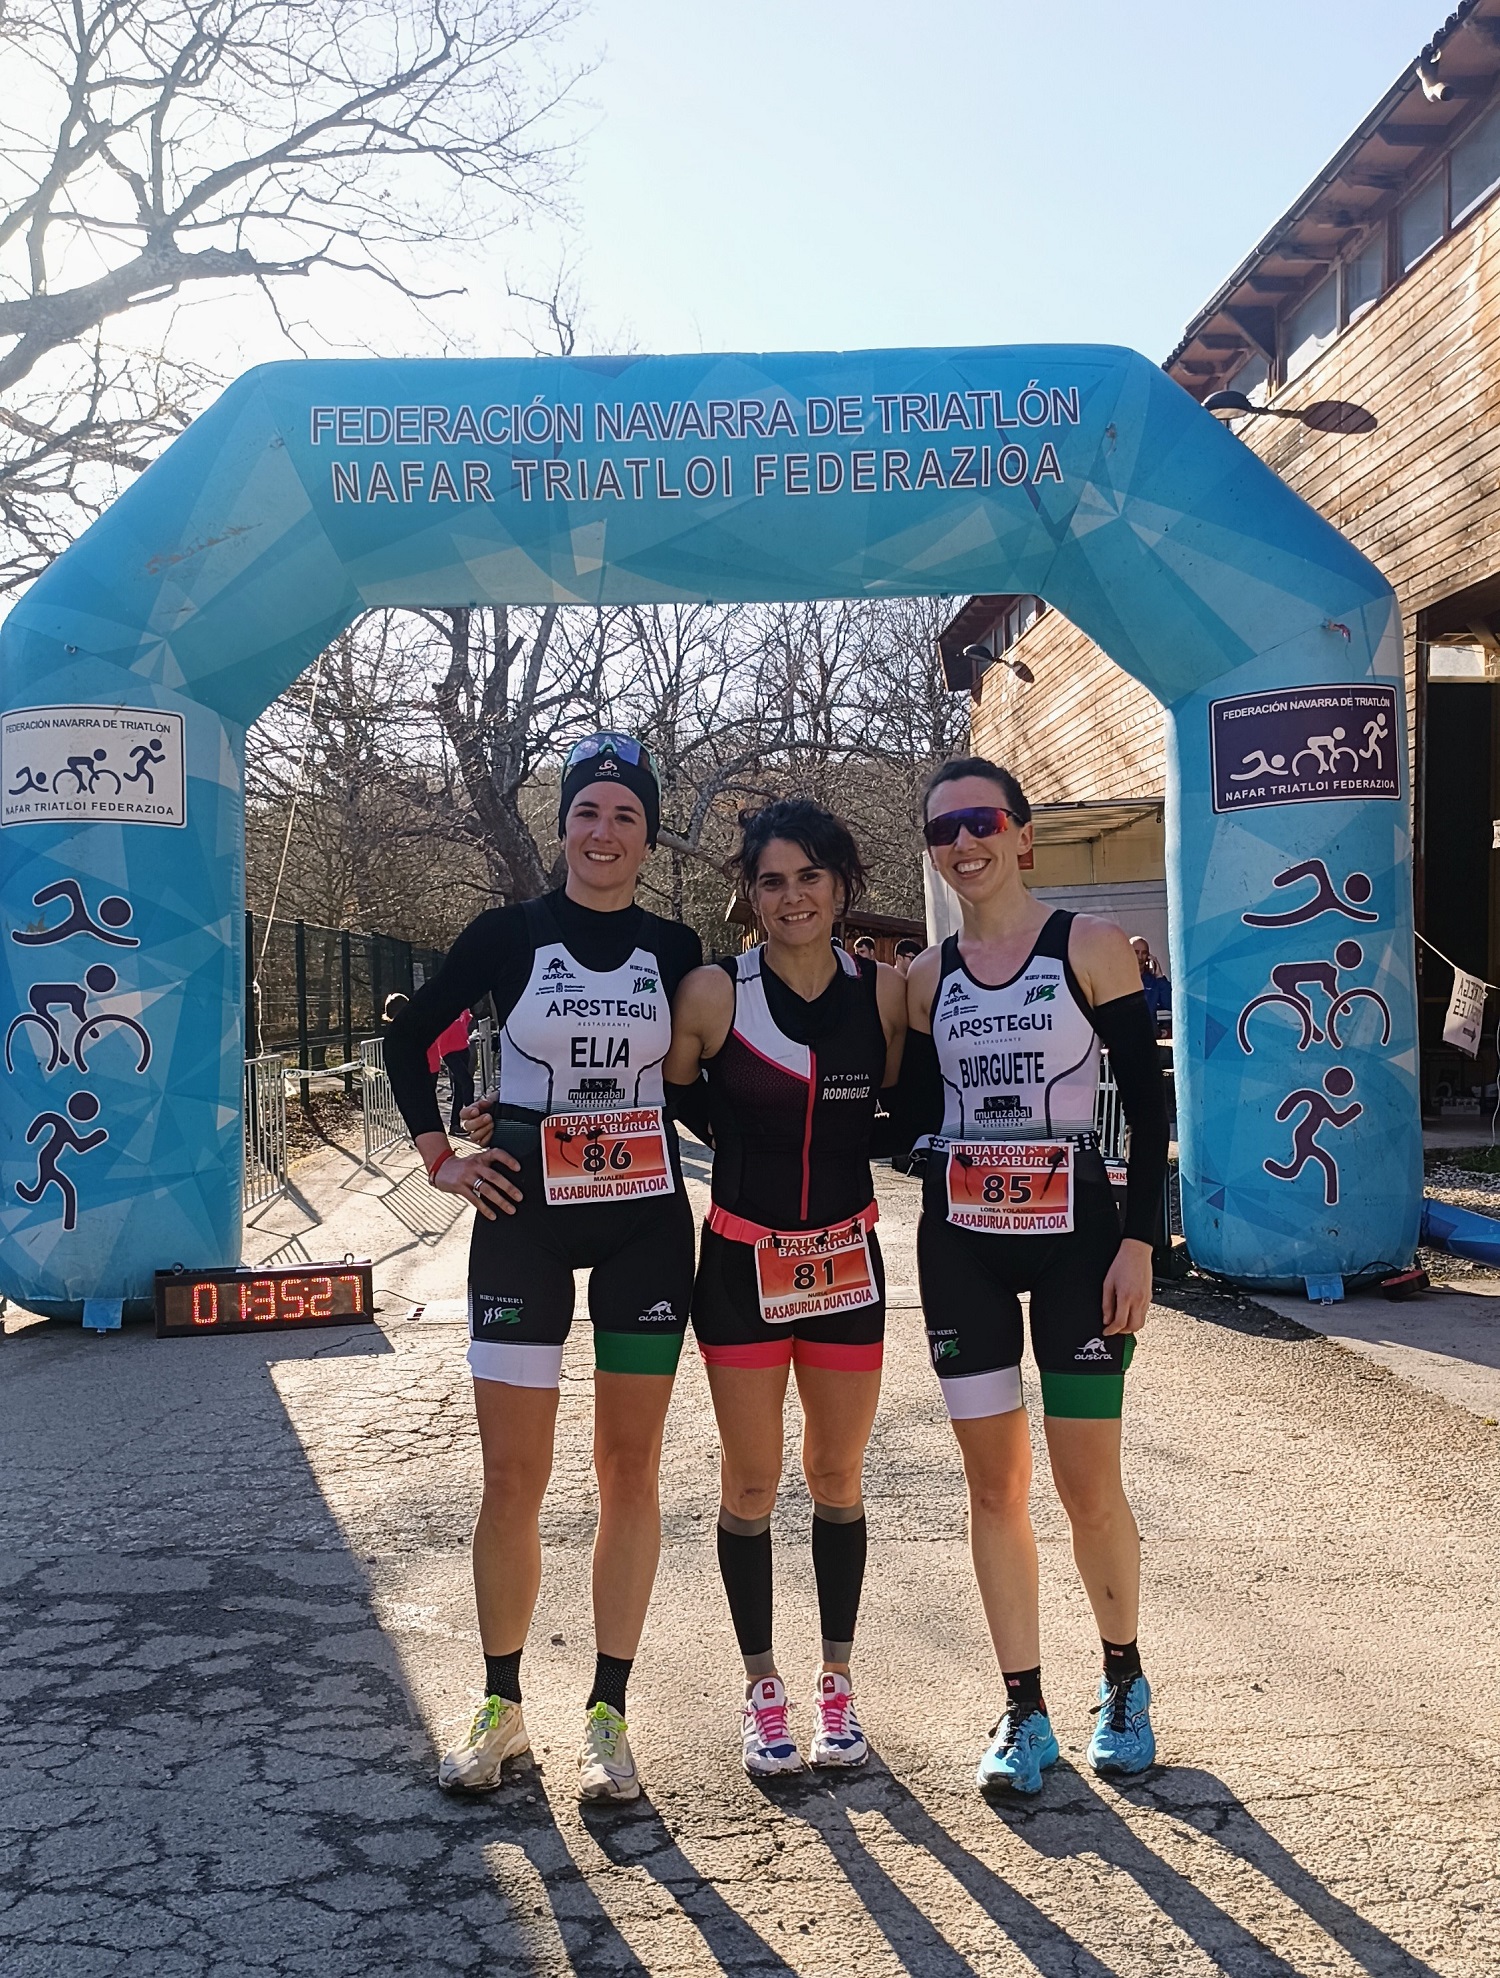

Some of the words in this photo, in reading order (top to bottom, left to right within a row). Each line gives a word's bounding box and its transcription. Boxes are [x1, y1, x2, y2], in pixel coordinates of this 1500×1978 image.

[310, 395, 583, 446] FEDERACIÓN
[595, 398, 798, 442] NAVARRA
[806, 395, 865, 437] DE
[872, 380, 1081, 434] TRIATLÓN
[331, 460, 496, 503] NAFAR
[512, 455, 732, 501] TRIATLOI
[755, 442, 1064, 497] FEDERAZIOA
[1222, 701, 1288, 721] FEDERACIÓN
[1290, 698, 1339, 710] NAVARRA
[1340, 697, 1353, 707] DE
[1355, 696, 1390, 708] TRIATLÓN
[5, 718, 51, 734] FEDERACIÓN
[52, 718, 100, 728] NAVARRA
[102, 719, 118, 729] DE
[120, 720, 171, 734] TRIATLÓN
[1225, 787, 1266, 802] NAFAR
[1270, 781, 1329, 795] TRIATLOI
[1333, 779, 1395, 790] FEDERAZIOA
[5, 804, 31, 815] NAFAR
[34, 802, 87, 812] TRIATLOI
[91, 802, 174, 816] FEDERAZIOA
[974, 1037, 1022, 1046] RESTAURANTE
[570, 1036, 630, 1069] ELIA
[823, 1073, 870, 1082] APTONIA
[958, 1051, 1046, 1089] BURGUETE
[569, 1088, 624, 1100] muruzabal
[822, 1086, 871, 1100] RODRIGUEZ
[545, 1118, 556, 1127] III
[560, 1113, 622, 1127] DUATLON
[975, 1106, 1031, 1120] muruzabal
[567, 1120, 659, 1136] BASABURUA
[582, 1140, 633, 1173] 86
[952, 1145, 963, 1155] III
[965, 1145, 1026, 1155] DUATLON
[549, 1184, 614, 1201] BASABURUA
[615, 1177, 669, 1194] DUATLOIA
[982, 1174, 1033, 1205] 85
[951, 1213, 1011, 1229] BASABURUA
[1013, 1215, 1068, 1230] DUATLOIA
[772, 1233, 831, 1248] UATLN
[792, 1257, 834, 1291] 81
[764, 1300, 822, 1320] BASABURUA
[824, 1289, 874, 1311] DUATLOIA
